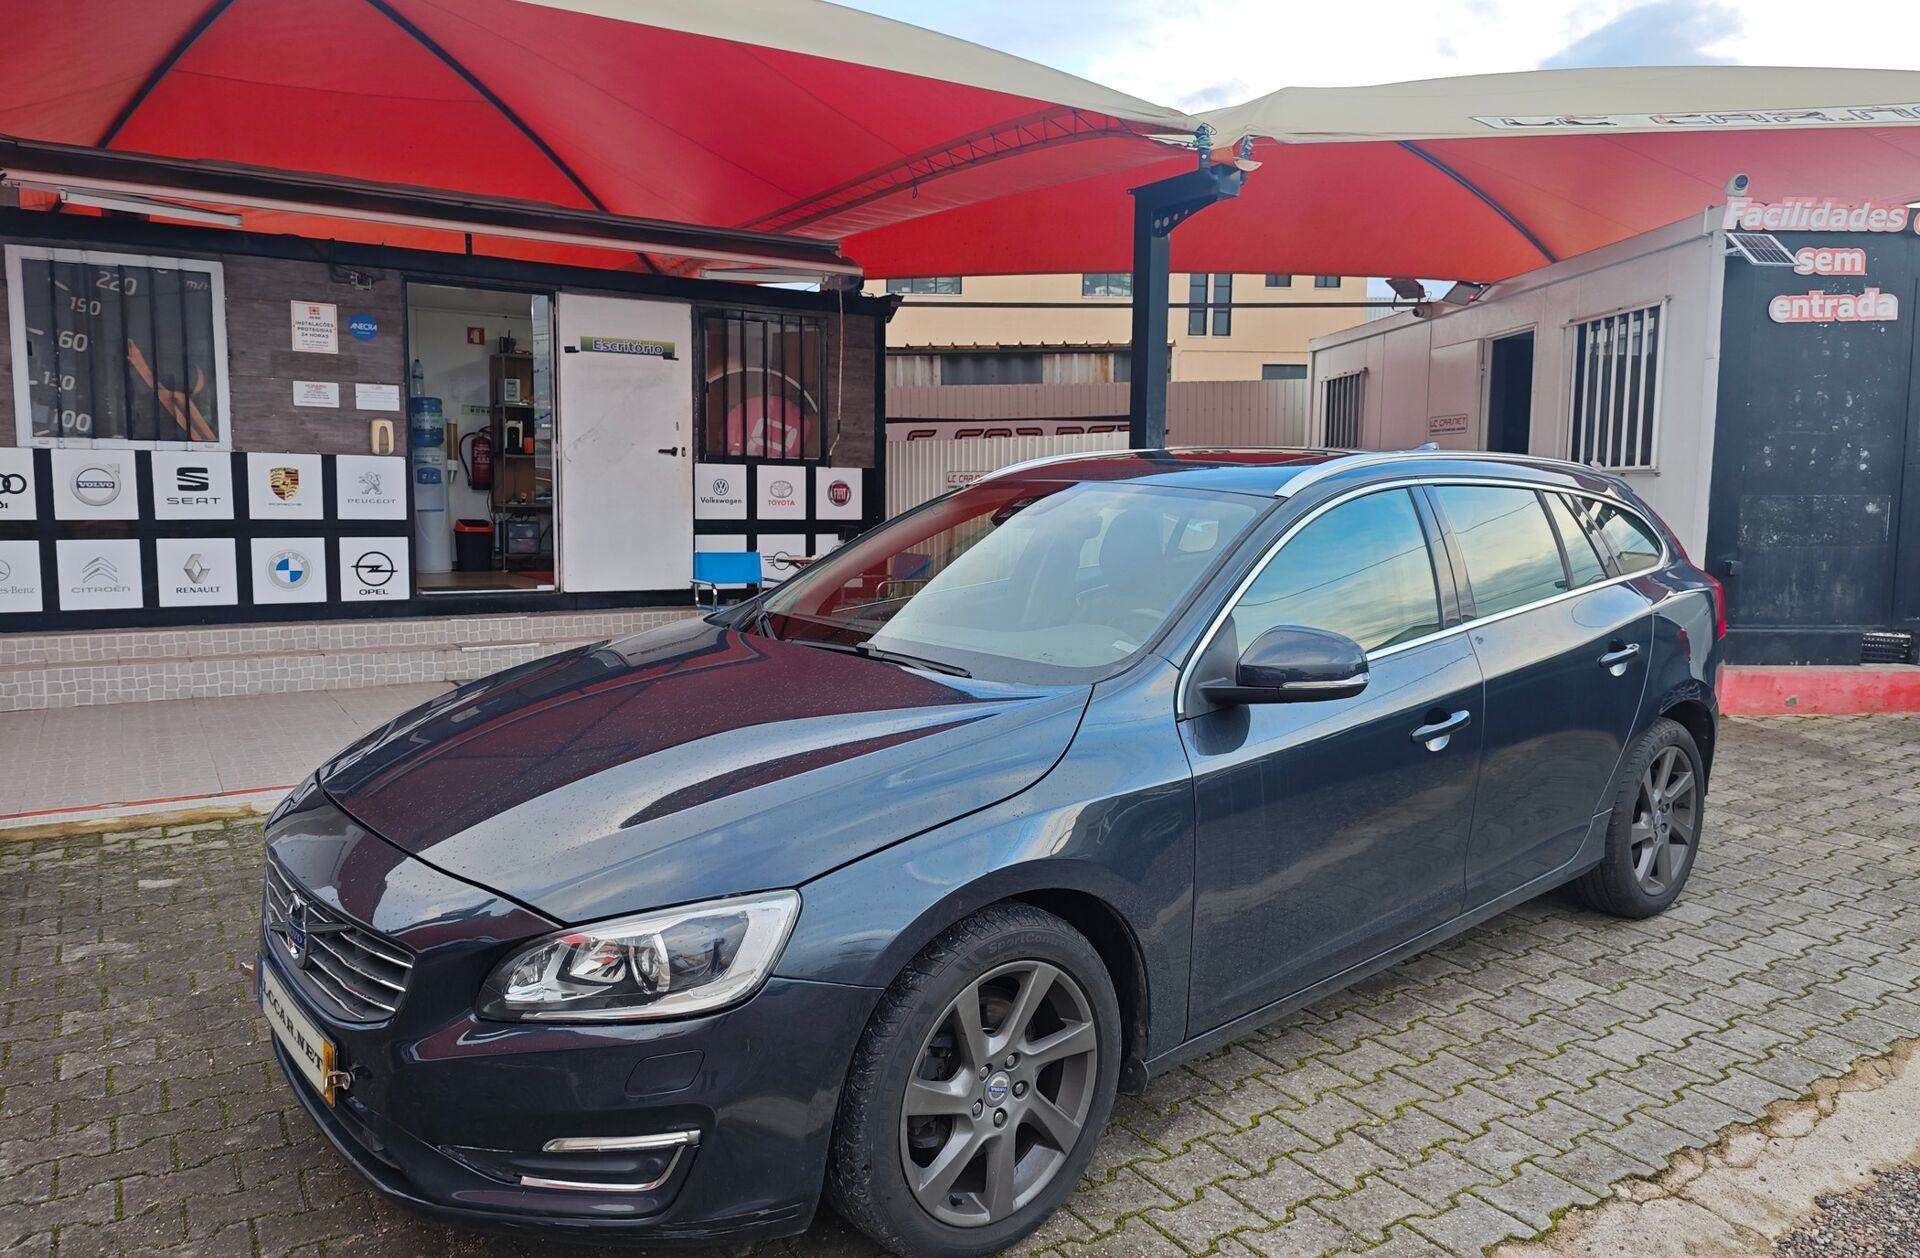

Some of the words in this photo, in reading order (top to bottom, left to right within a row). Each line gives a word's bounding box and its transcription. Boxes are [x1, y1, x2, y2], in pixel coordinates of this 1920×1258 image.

[1726, 200, 1907, 230] Facilidades
[1797, 249, 1864, 273] sem
[95, 271, 137, 296] 220
[1771, 290, 1898, 320] entrada
[834, 487, 847, 500] FIAT
[167, 497, 221, 505] SEAT
[700, 497, 742, 505] Volkswagen
[175, 586, 220, 594] RENAULT
[359, 588, 390, 596] OPEL
